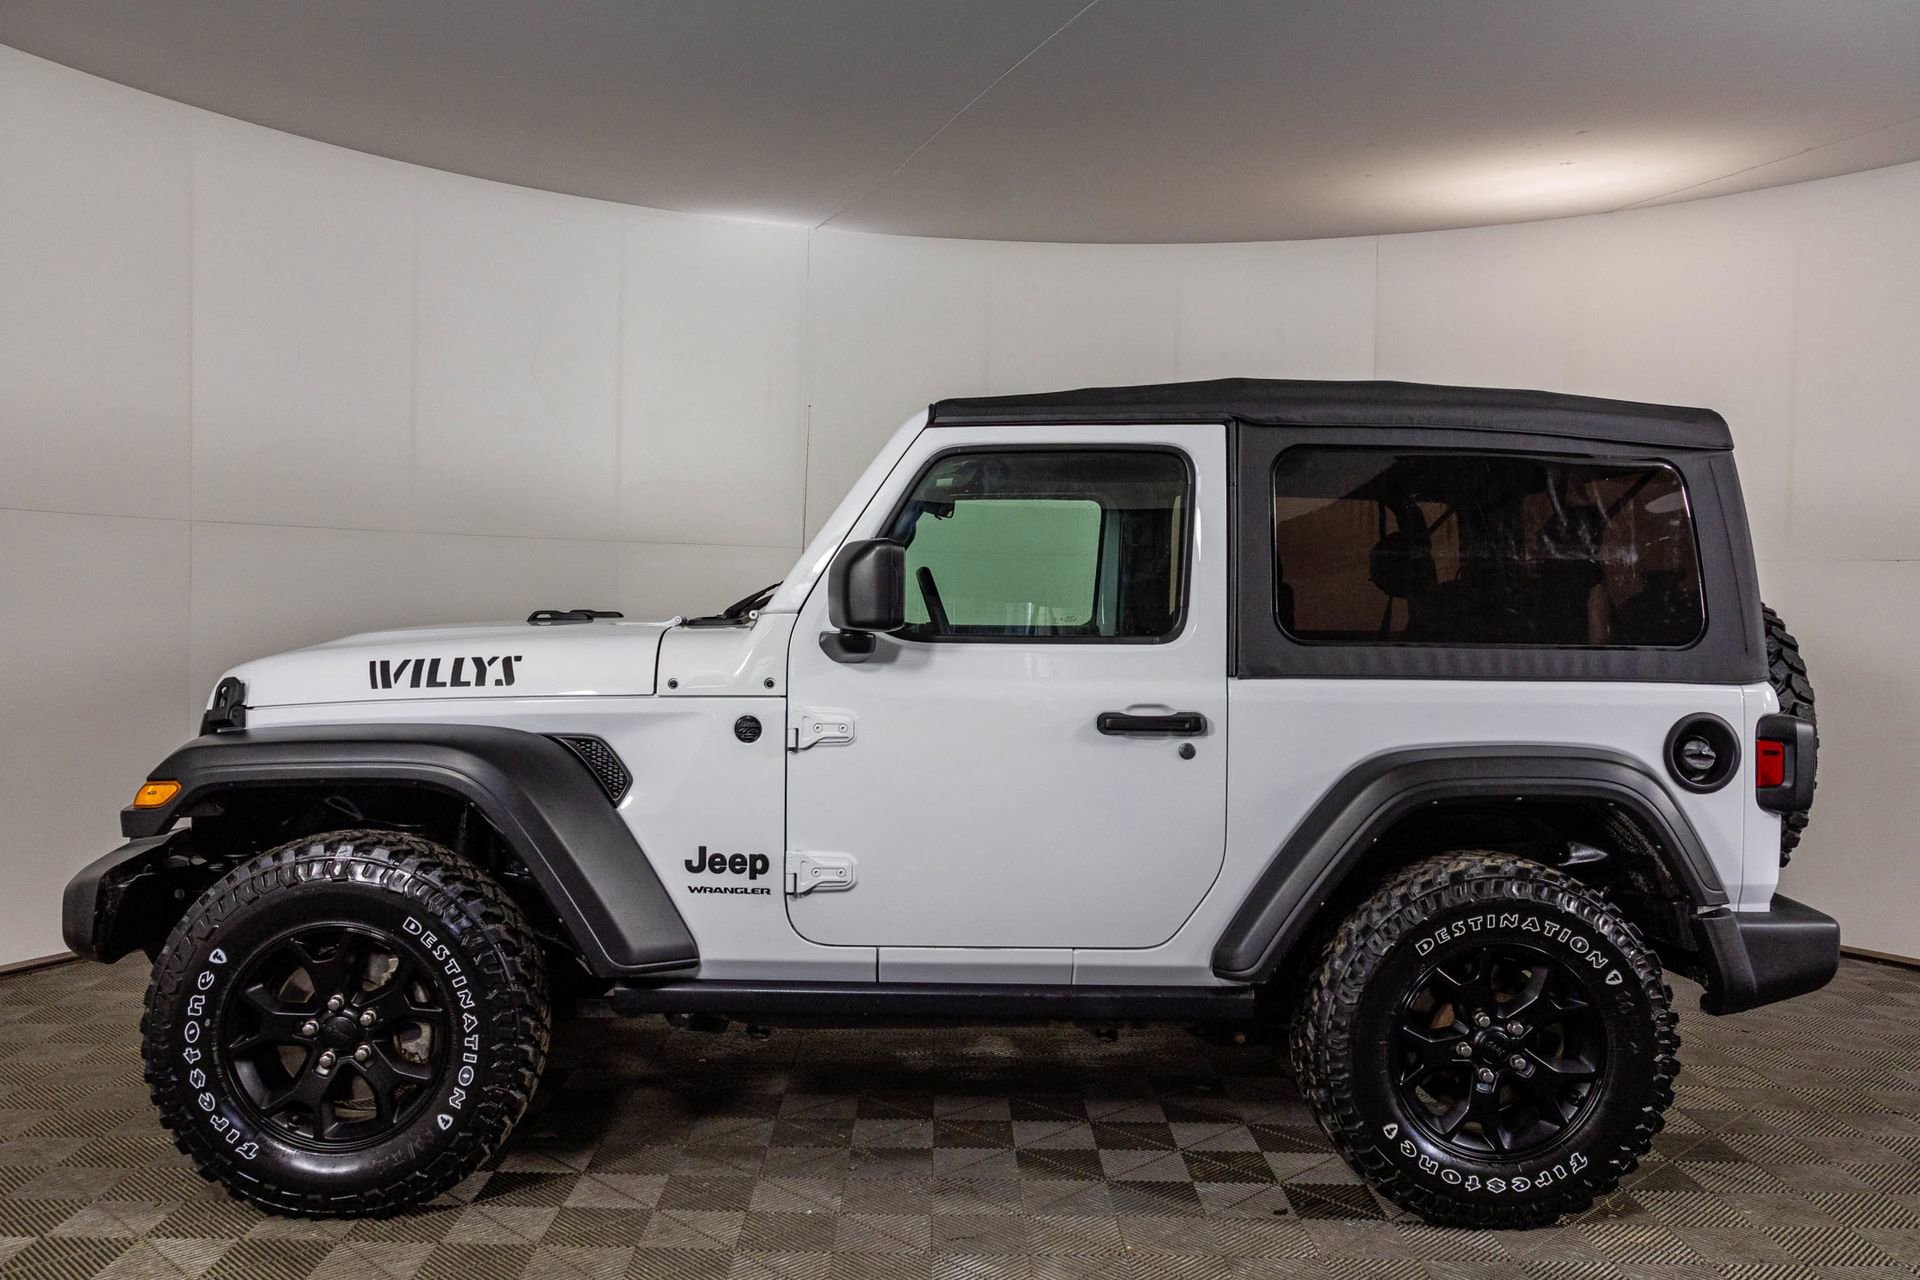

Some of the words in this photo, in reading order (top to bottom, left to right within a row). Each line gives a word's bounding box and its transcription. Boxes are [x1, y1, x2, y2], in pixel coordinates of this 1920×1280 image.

[369, 655, 523, 690] WILLYS
[684, 845, 770, 880] Jeep
[687, 885, 771, 895] WRANGLER
[1415, 913, 1608, 969] DESTINATION
[402, 916, 480, 1110] DESTINATION
[183, 971, 259, 1161] Firestone
[1400, 1139, 1588, 1193] Firestone
